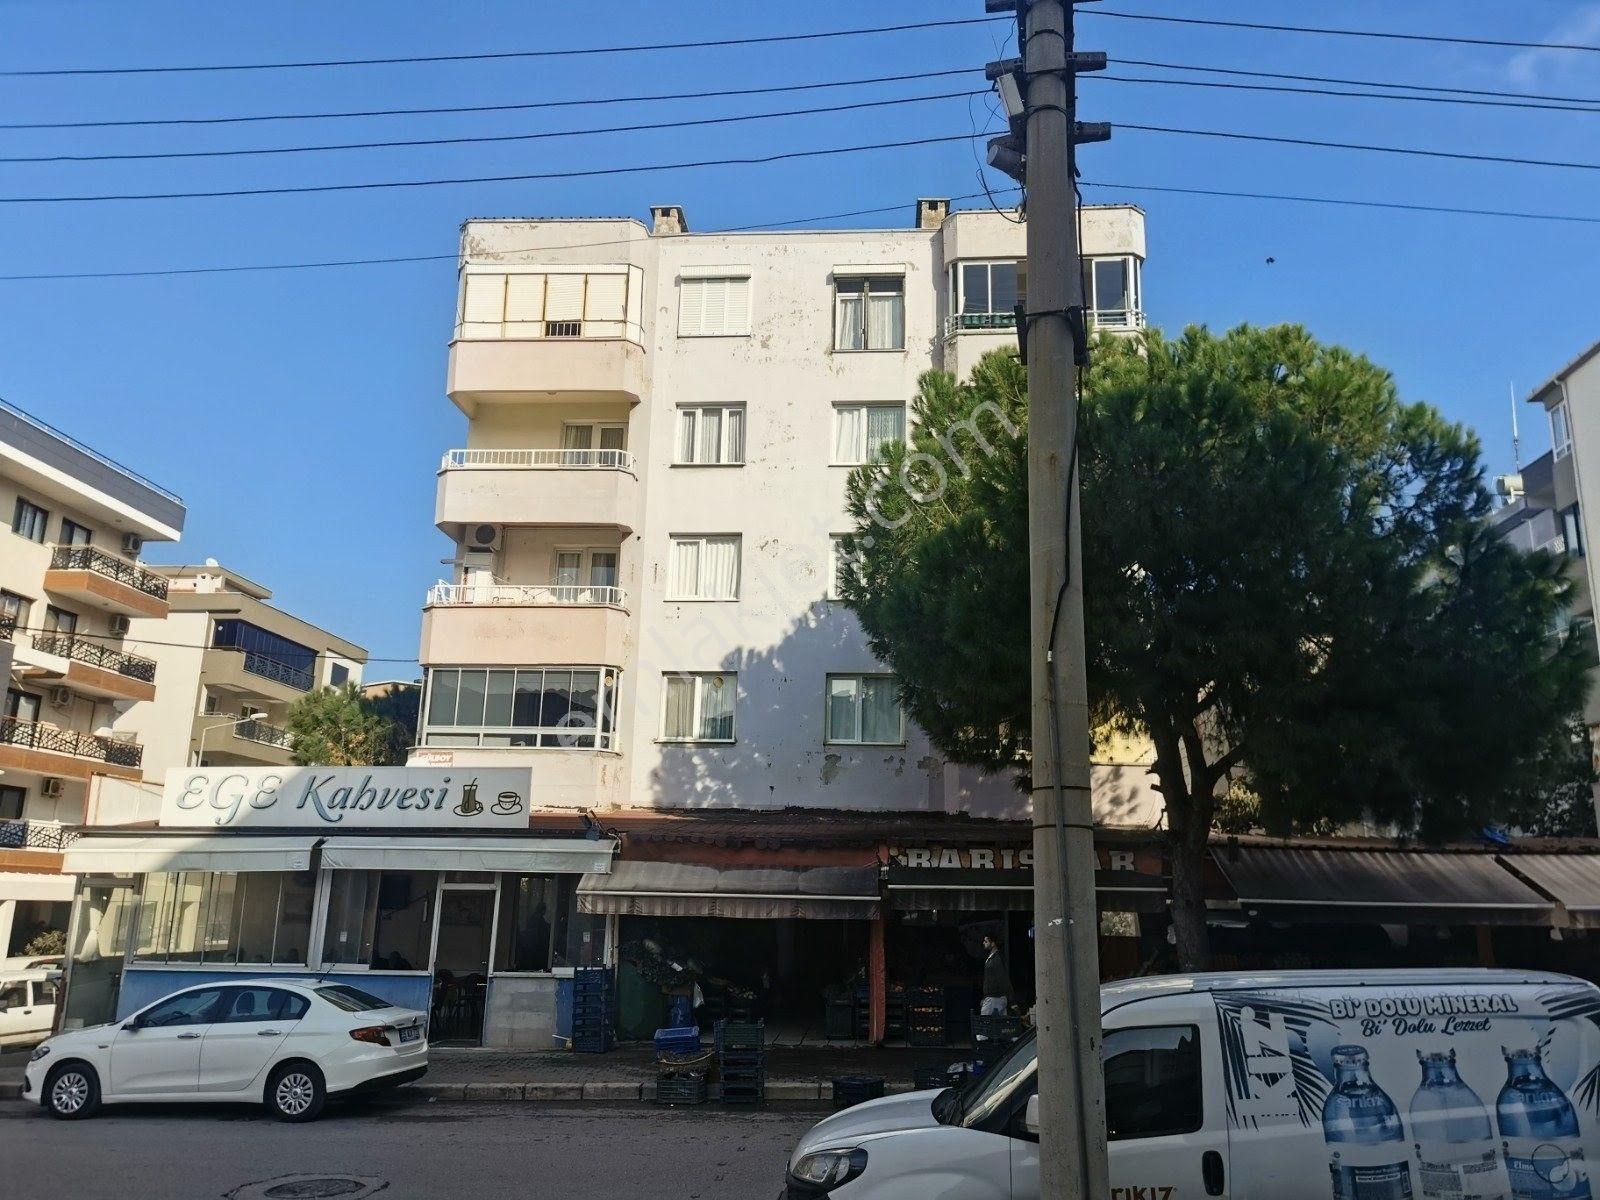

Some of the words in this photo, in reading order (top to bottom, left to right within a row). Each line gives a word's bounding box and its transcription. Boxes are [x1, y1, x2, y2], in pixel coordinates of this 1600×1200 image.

[176, 773, 283, 825] EGE
[297, 774, 451, 823] Kahvesi
[1365, 997, 1421, 1017] DOLU
[1392, 1017, 1436, 1036] Dolu
[1441, 1016, 1492, 1036] Lezzet
